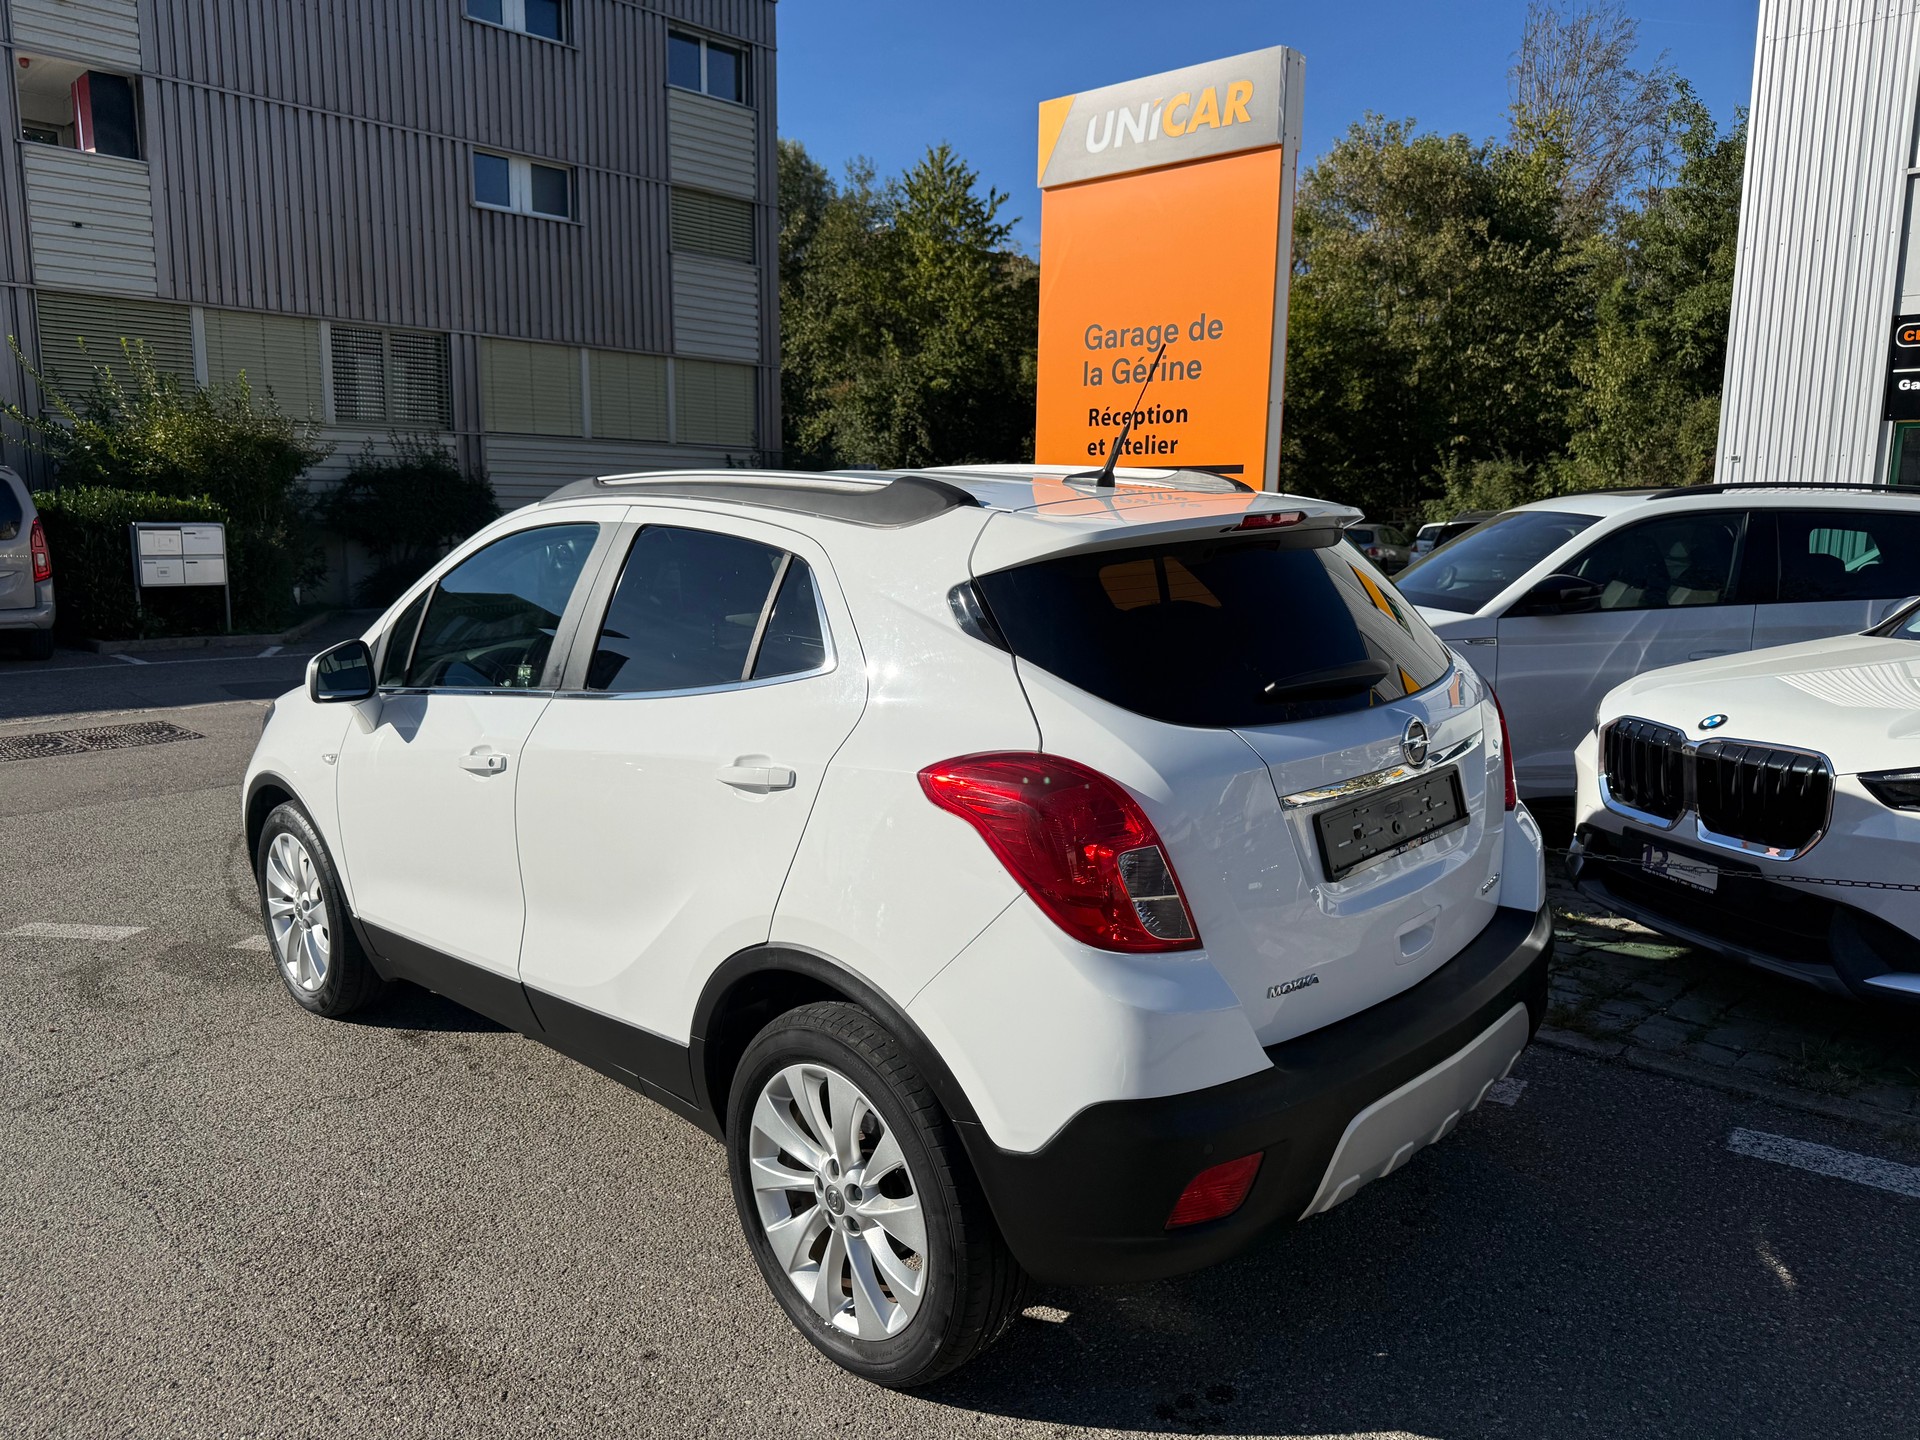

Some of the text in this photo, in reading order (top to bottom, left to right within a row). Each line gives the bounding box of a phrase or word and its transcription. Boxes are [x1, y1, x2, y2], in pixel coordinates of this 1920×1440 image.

[1084, 313, 1224, 352] Garage de
[1083, 361, 1103, 386] la
[1088, 404, 1188, 430] Réception
[1087, 438, 1105, 456] et
[1267, 973, 1319, 999] MOKKA
